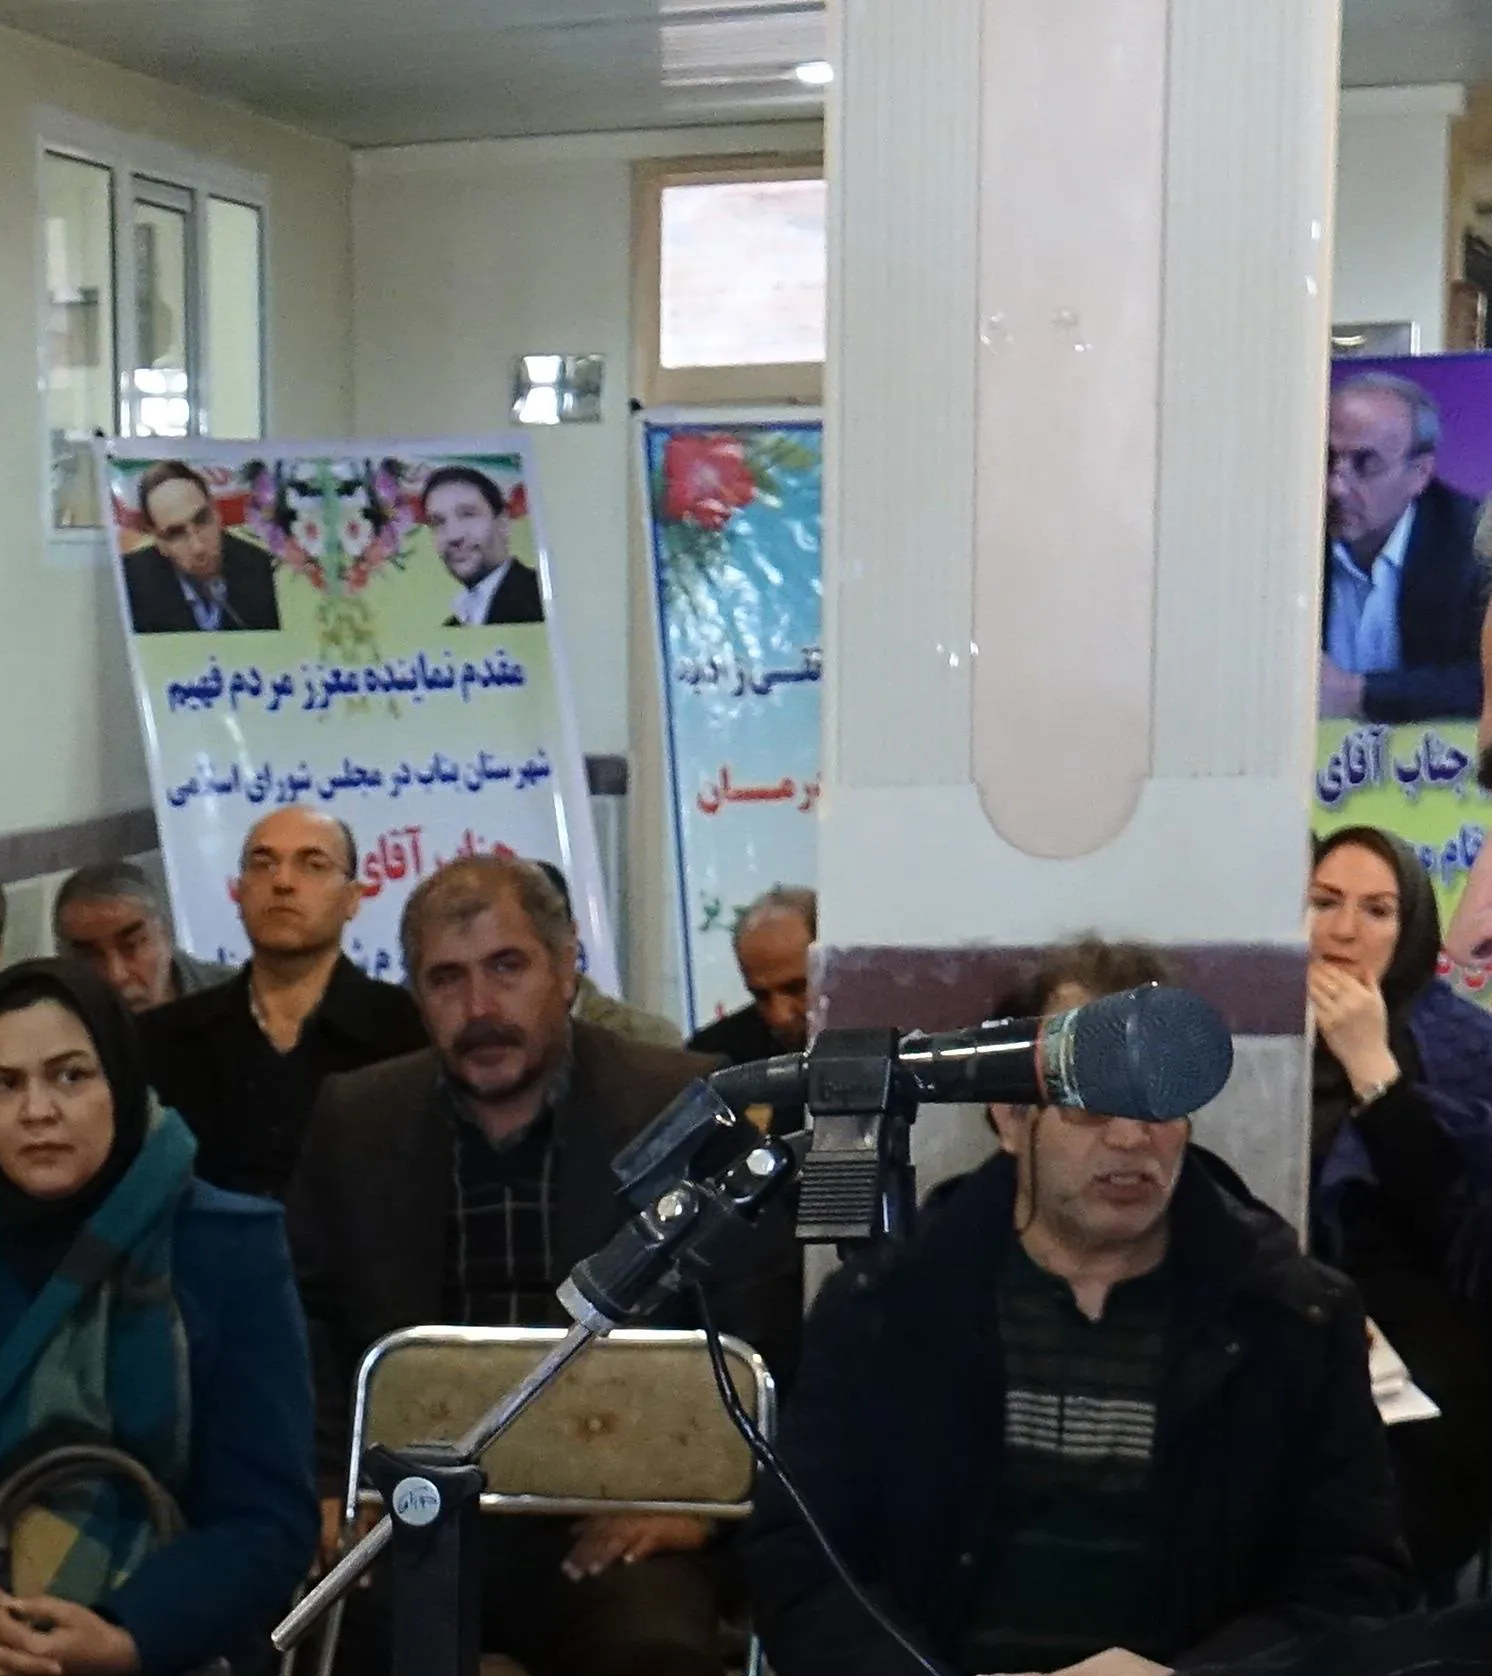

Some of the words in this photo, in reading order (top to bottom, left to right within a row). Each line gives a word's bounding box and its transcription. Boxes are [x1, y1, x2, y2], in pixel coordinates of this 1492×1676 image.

[167, 655, 224, 712] فهیم
[230, 666, 294, 711] مردم
[365, 651, 457, 703] نماینده
[462, 650, 526, 702] مقدم
[247, 761, 312, 803] شورای
[319, 757, 382, 799] مجلس
[390, 762, 411, 797] در
[418, 752, 459, 790] بناب
[463, 747, 552, 792] شهرستان
[1317, 724, 1388, 804] آقای
[1395, 731, 1469, 801] جناب
[360, 824, 423, 898] آقای
